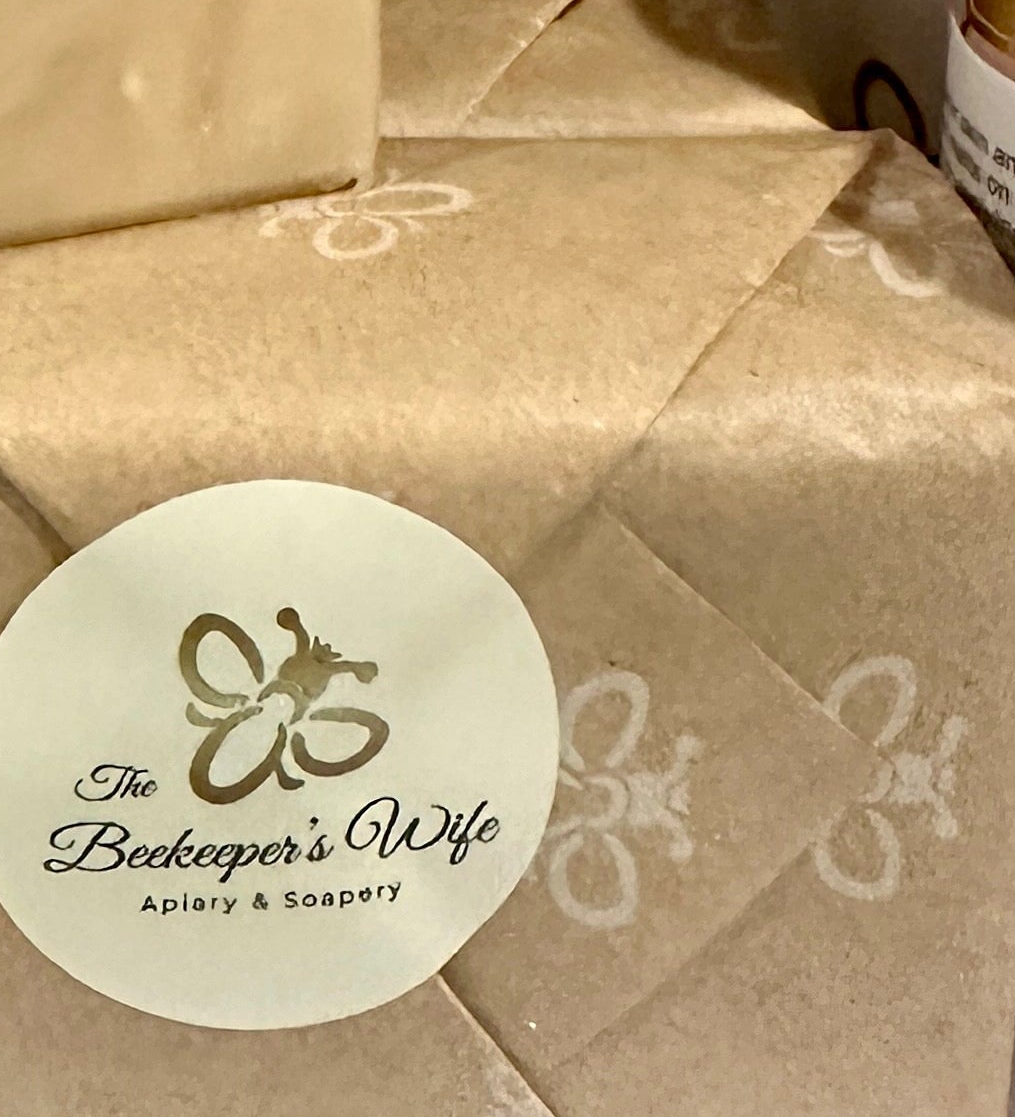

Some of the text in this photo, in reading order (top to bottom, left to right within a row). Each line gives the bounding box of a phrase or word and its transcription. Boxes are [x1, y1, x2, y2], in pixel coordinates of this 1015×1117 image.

[73, 763, 158, 802] The
[43, 795, 501, 883] Beekeeper's Wife
[251, 892, 269, 911] &
[284, 880, 403, 911] Soapery
